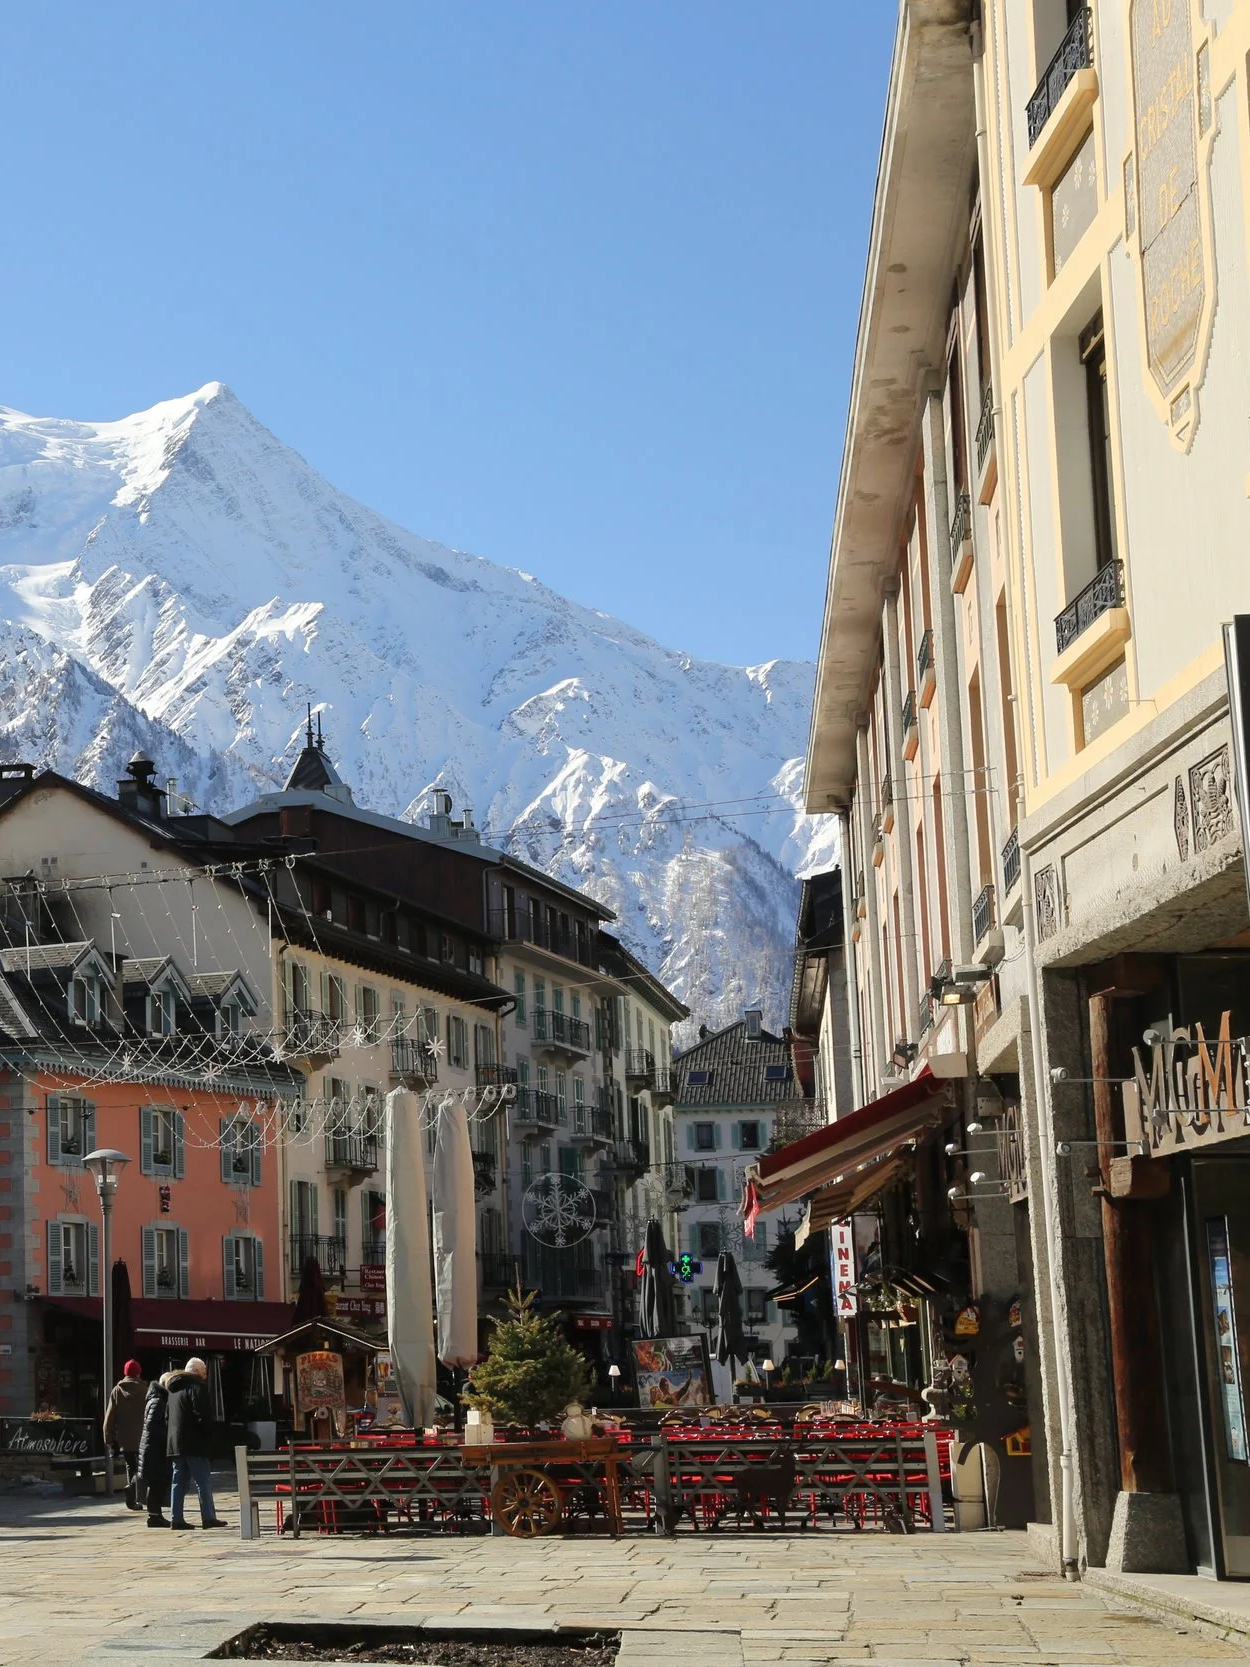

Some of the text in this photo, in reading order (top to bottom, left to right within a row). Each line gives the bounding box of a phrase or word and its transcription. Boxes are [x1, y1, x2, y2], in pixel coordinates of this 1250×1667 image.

[1140, 52, 1194, 161] CRISTAL
[1157, 163, 1183, 228] DE
[1149, 238, 1203, 338] ROCHE
[161, 1336, 189, 1346] BRASSERIE
[195, 1338, 206, 1347] BAR
[233, 1338, 241, 1349] LE
[300, 1353, 338, 1365] PIZZAS
